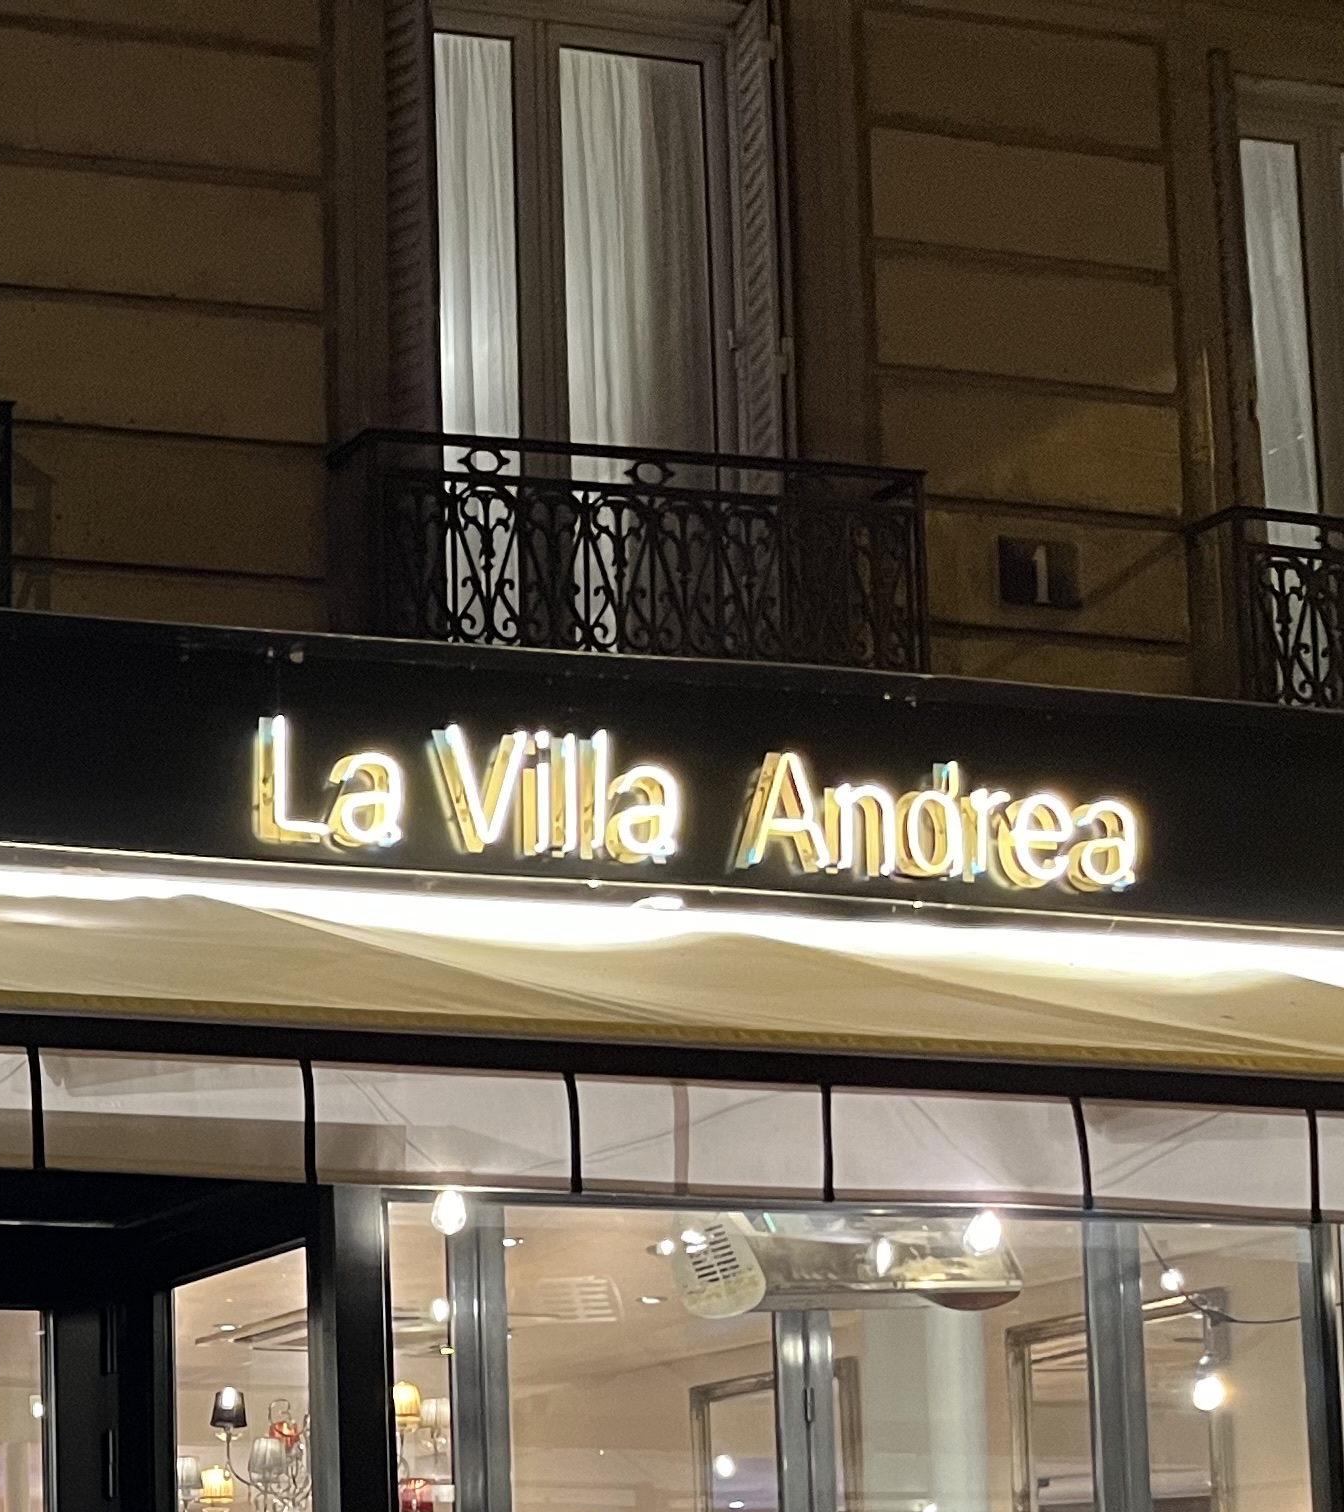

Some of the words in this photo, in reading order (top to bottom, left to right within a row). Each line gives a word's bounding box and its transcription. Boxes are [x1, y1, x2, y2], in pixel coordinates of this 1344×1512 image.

[1033, 545, 1050, 604] 1
[252, 712, 406, 849] La
[430, 722, 679, 863] Villa
[733, 750, 1141, 893] Andrea
